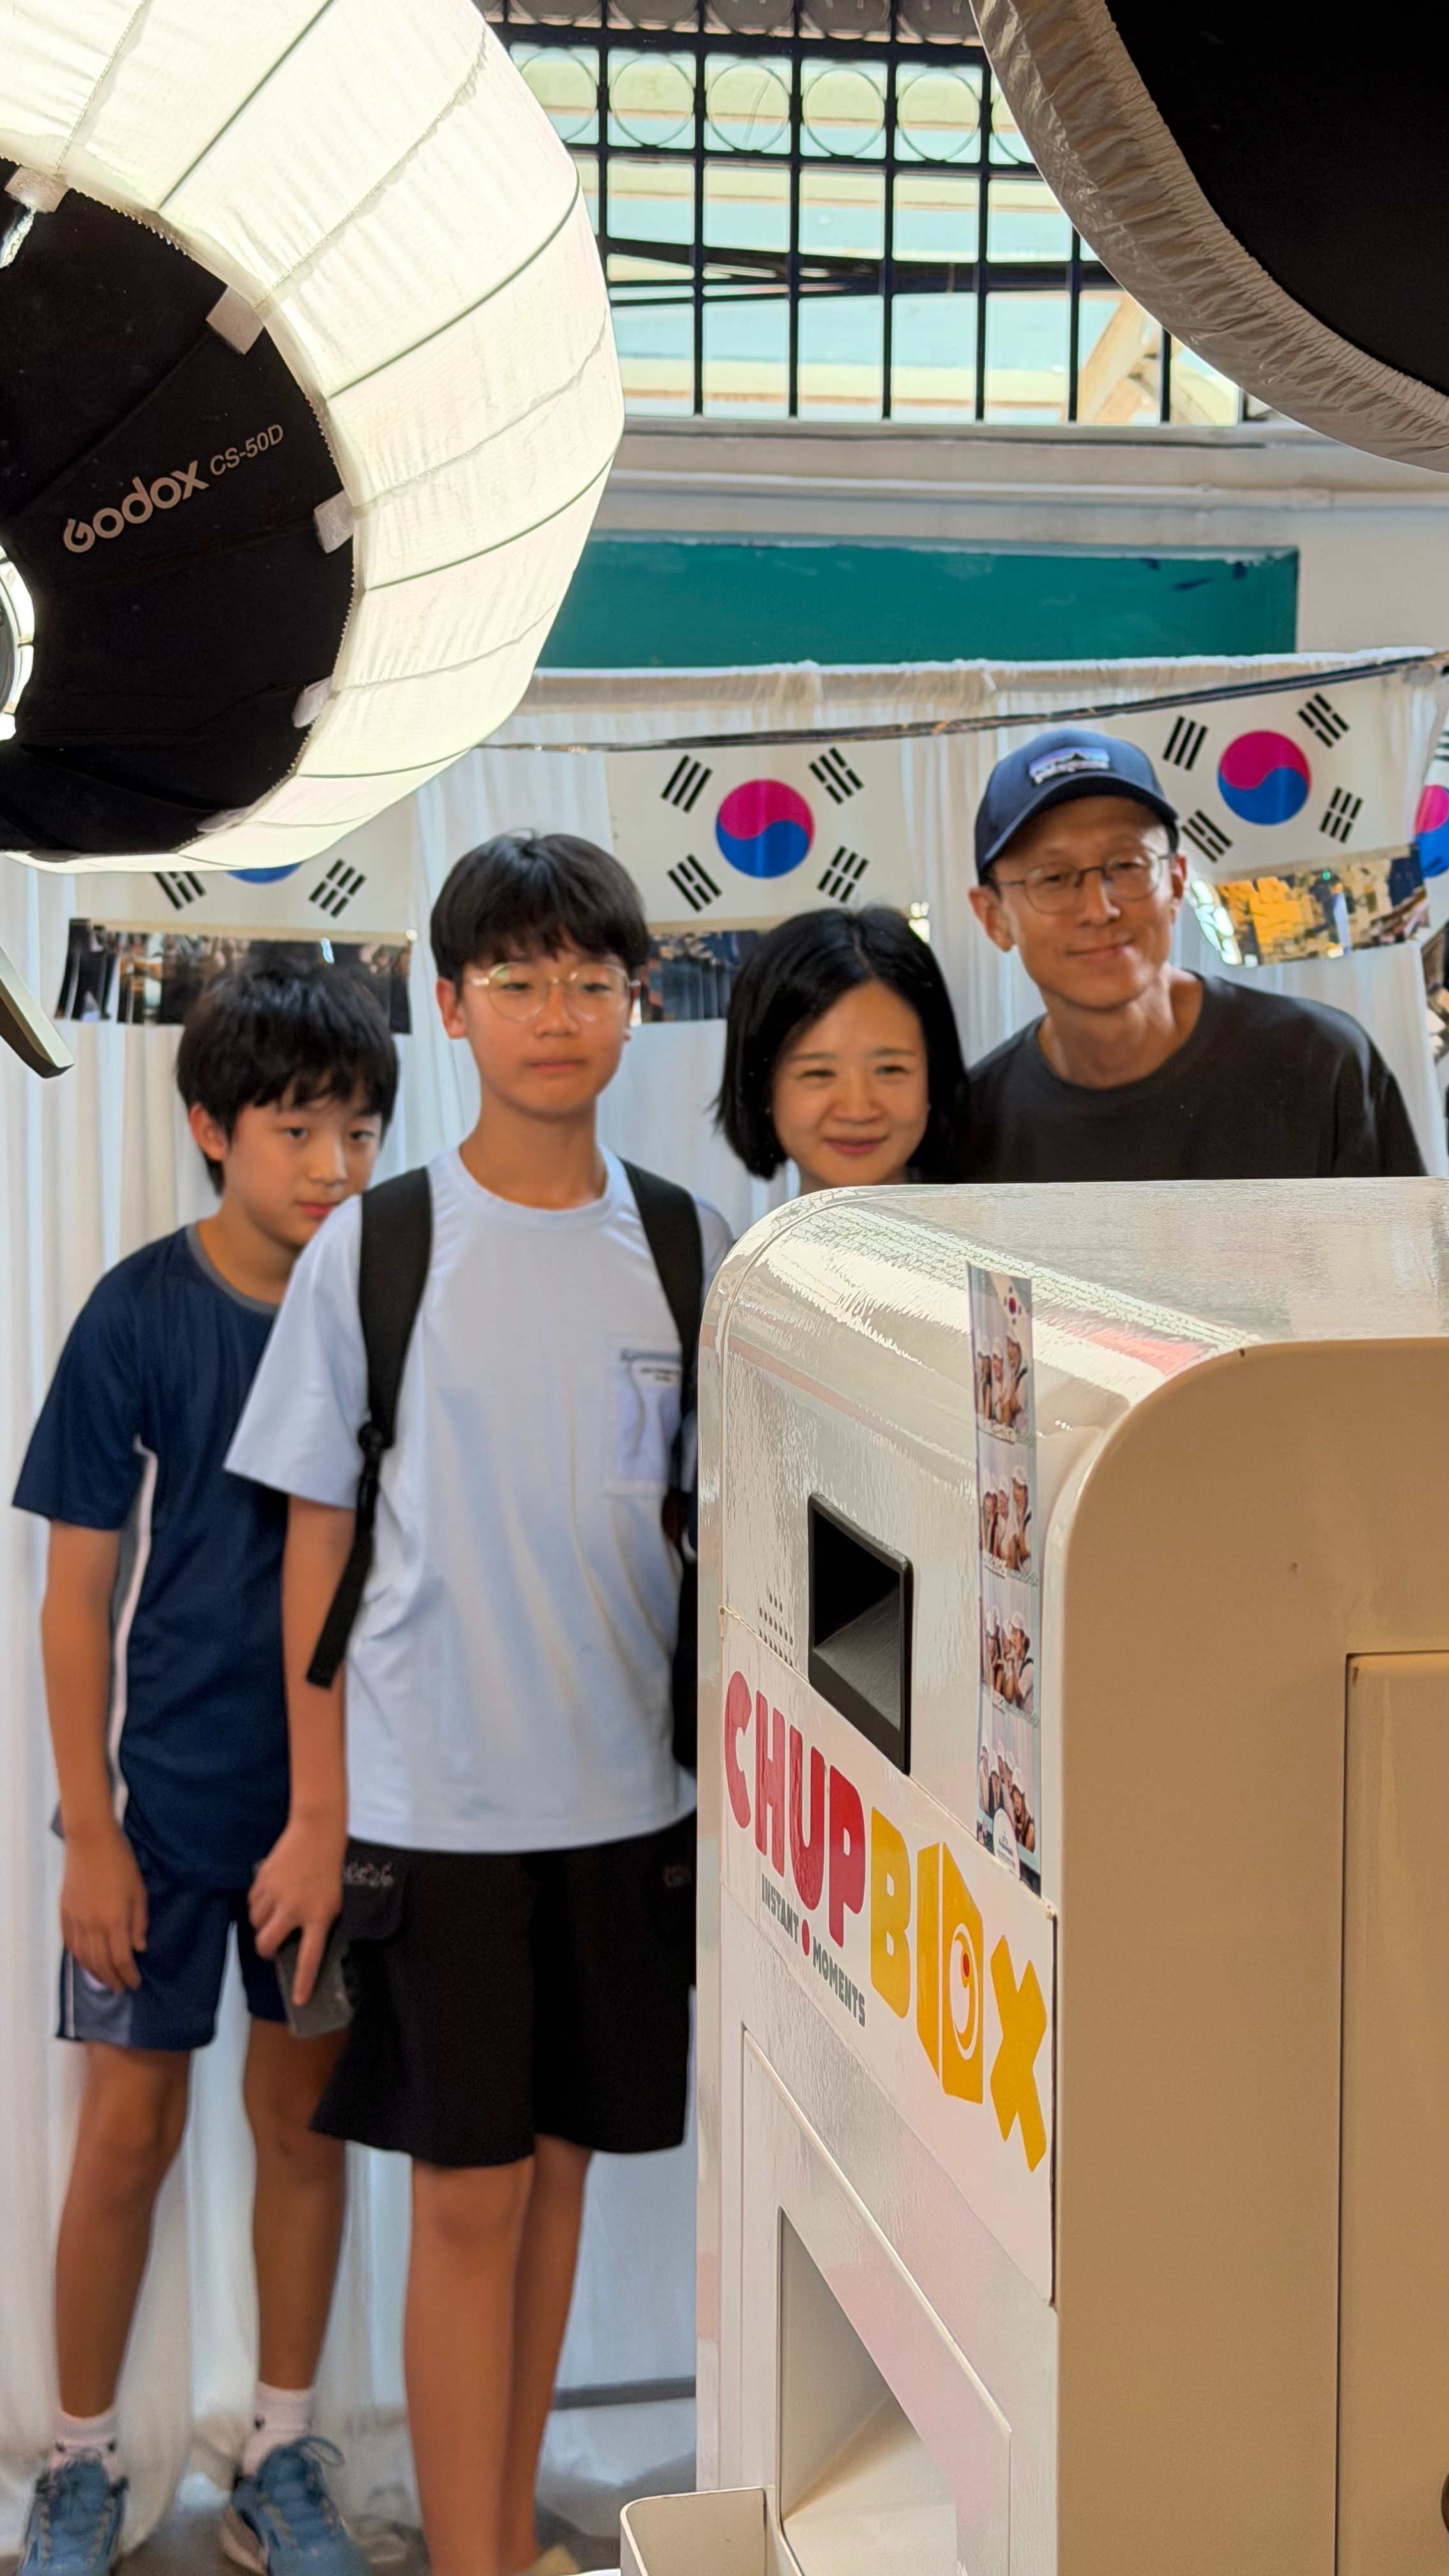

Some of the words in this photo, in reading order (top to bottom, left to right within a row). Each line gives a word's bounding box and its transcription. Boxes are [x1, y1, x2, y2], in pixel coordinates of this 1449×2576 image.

[63, 460, 210, 553] Godox
[210, 424, 284, 476] CS-50D
[762, 1872, 799, 1944] INSTANT
[812, 1936, 866, 2028] MOMENTS
